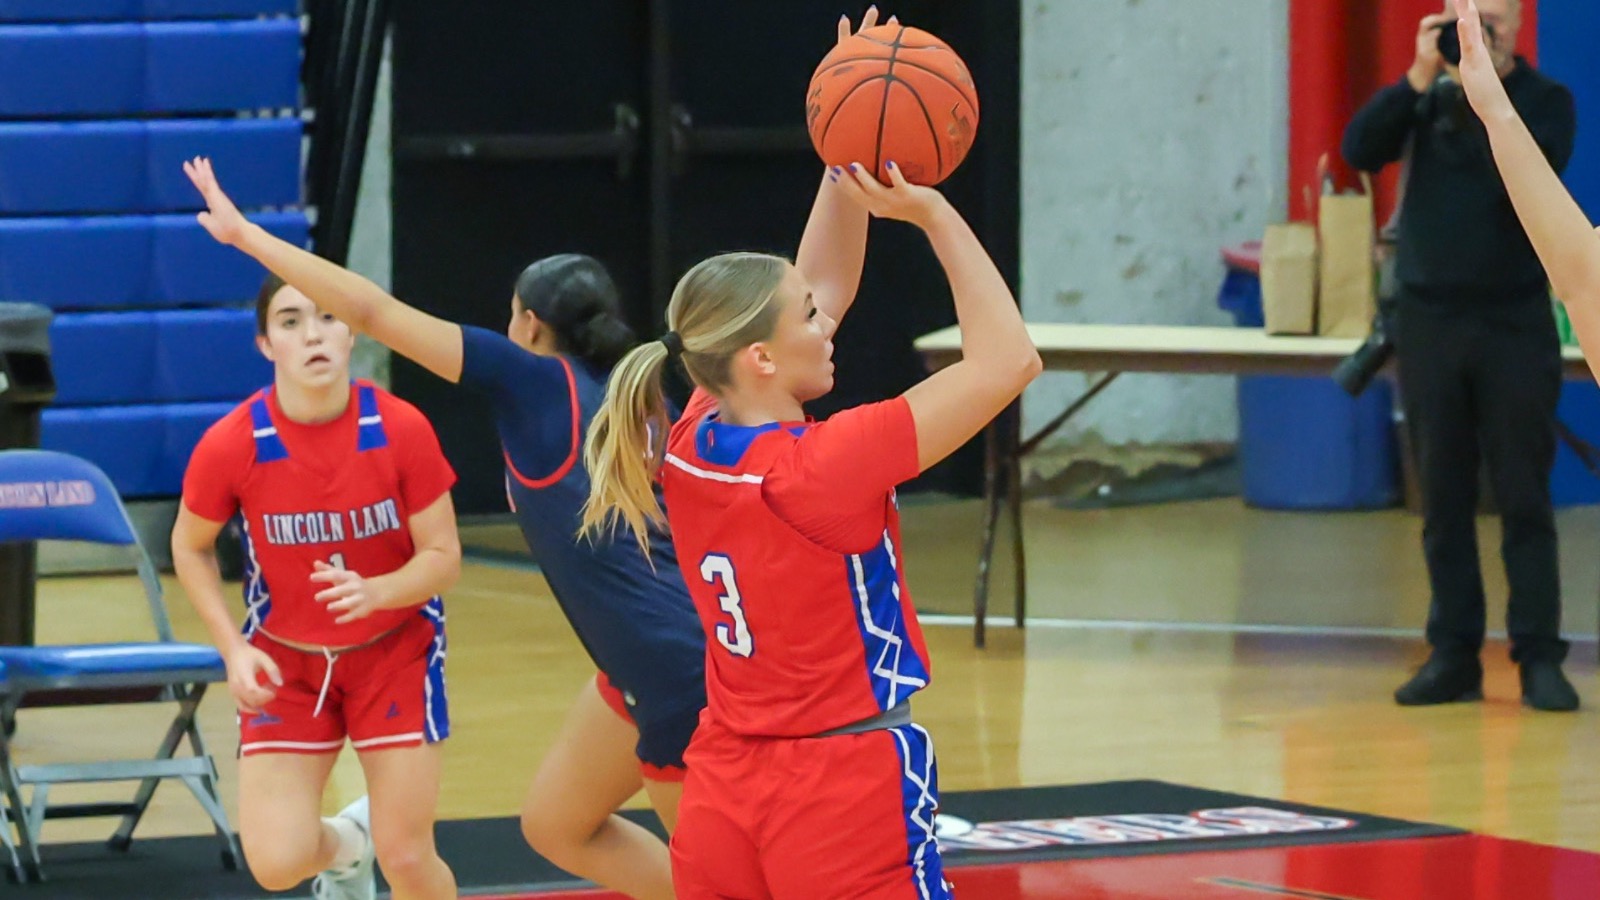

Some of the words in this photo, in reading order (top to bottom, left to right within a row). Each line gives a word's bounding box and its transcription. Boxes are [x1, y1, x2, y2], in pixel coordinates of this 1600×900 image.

[263, 512, 344, 544] LINCOLN
[349, 498, 400, 539] LAND
[700, 552, 754, 658] 3
